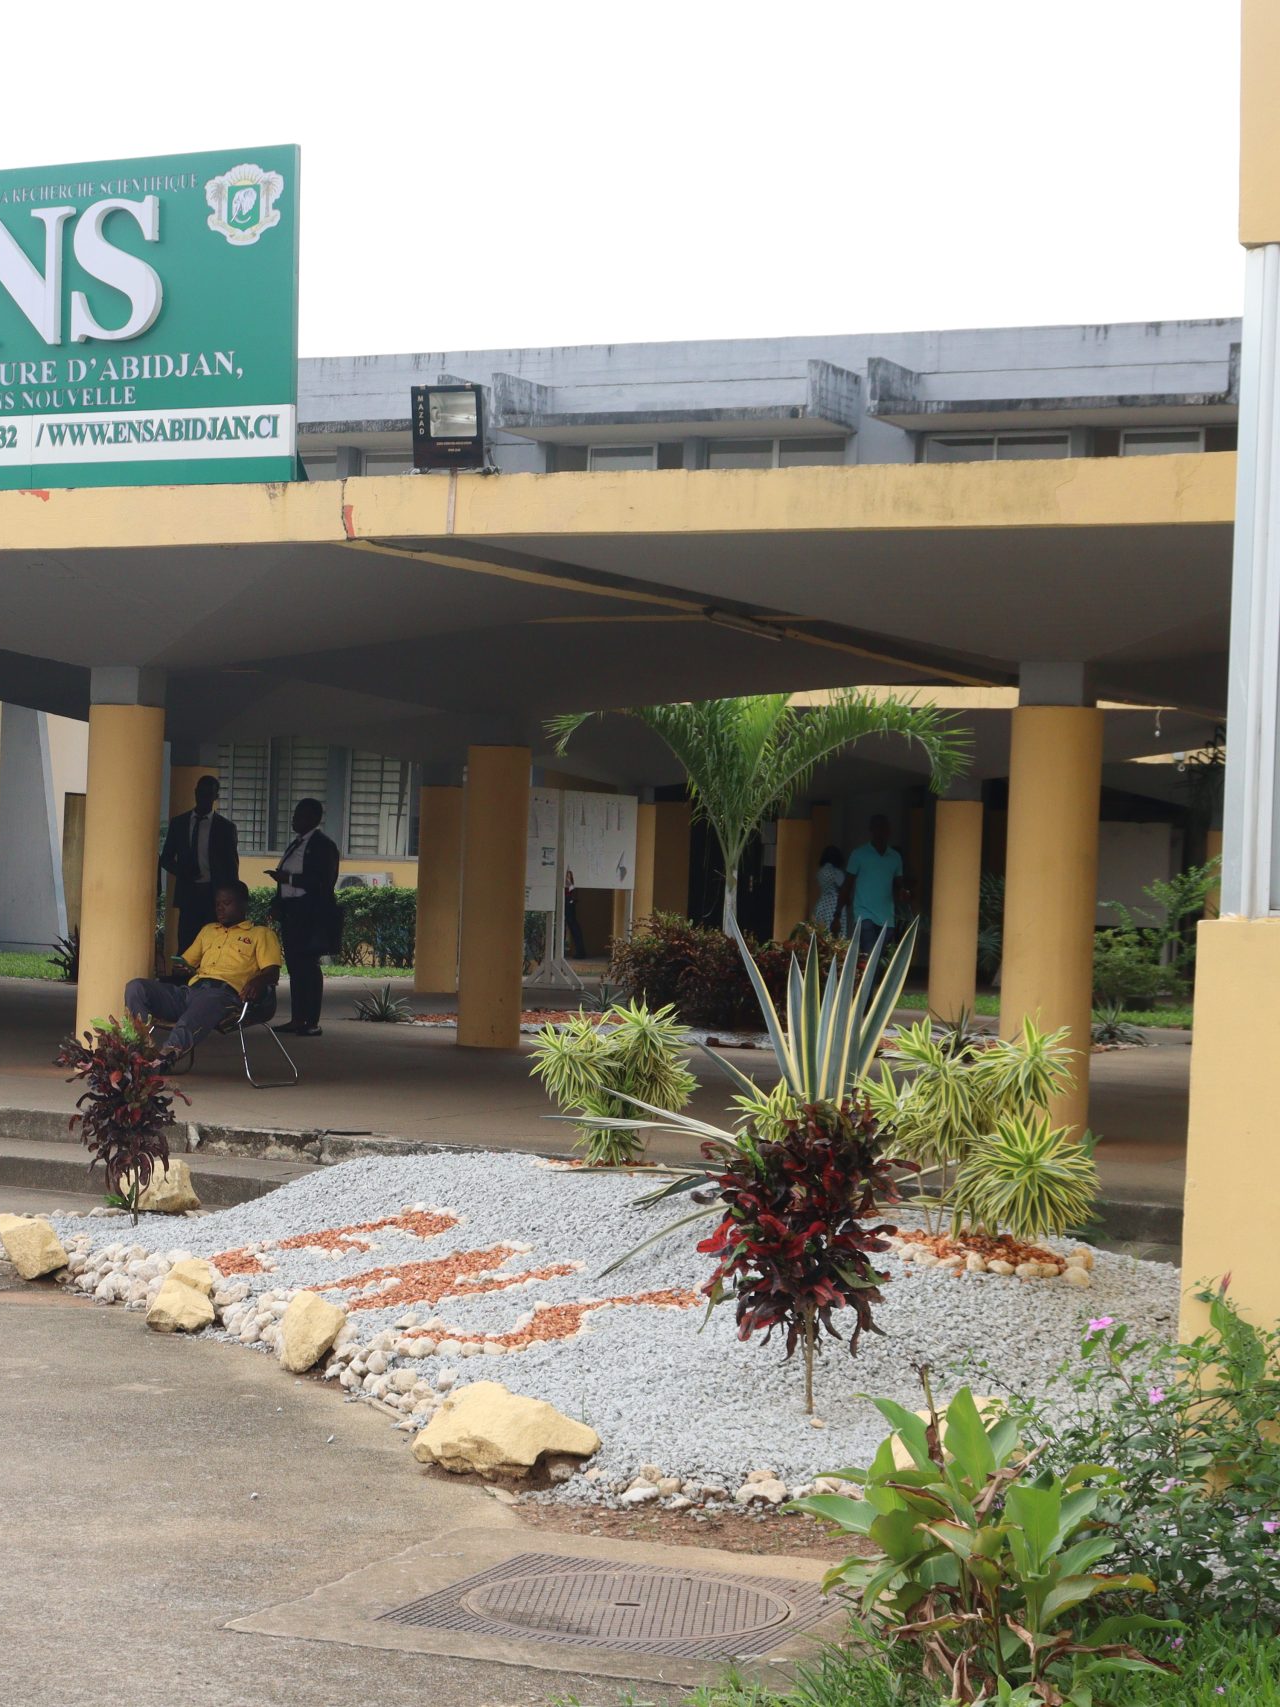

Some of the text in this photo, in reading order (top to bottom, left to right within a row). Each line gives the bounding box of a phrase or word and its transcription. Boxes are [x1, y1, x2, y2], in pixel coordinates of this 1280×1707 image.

[12, 182, 94, 204] RECHERCHE
[100, 173, 197, 196] SCIENTIFIQUE
[68, 351, 244, 383] D'ABIDJAN,
[22, 386, 137, 410] NOUVELLE
[46, 414, 280, 447] WWW.ENSABIDJAN.CI
